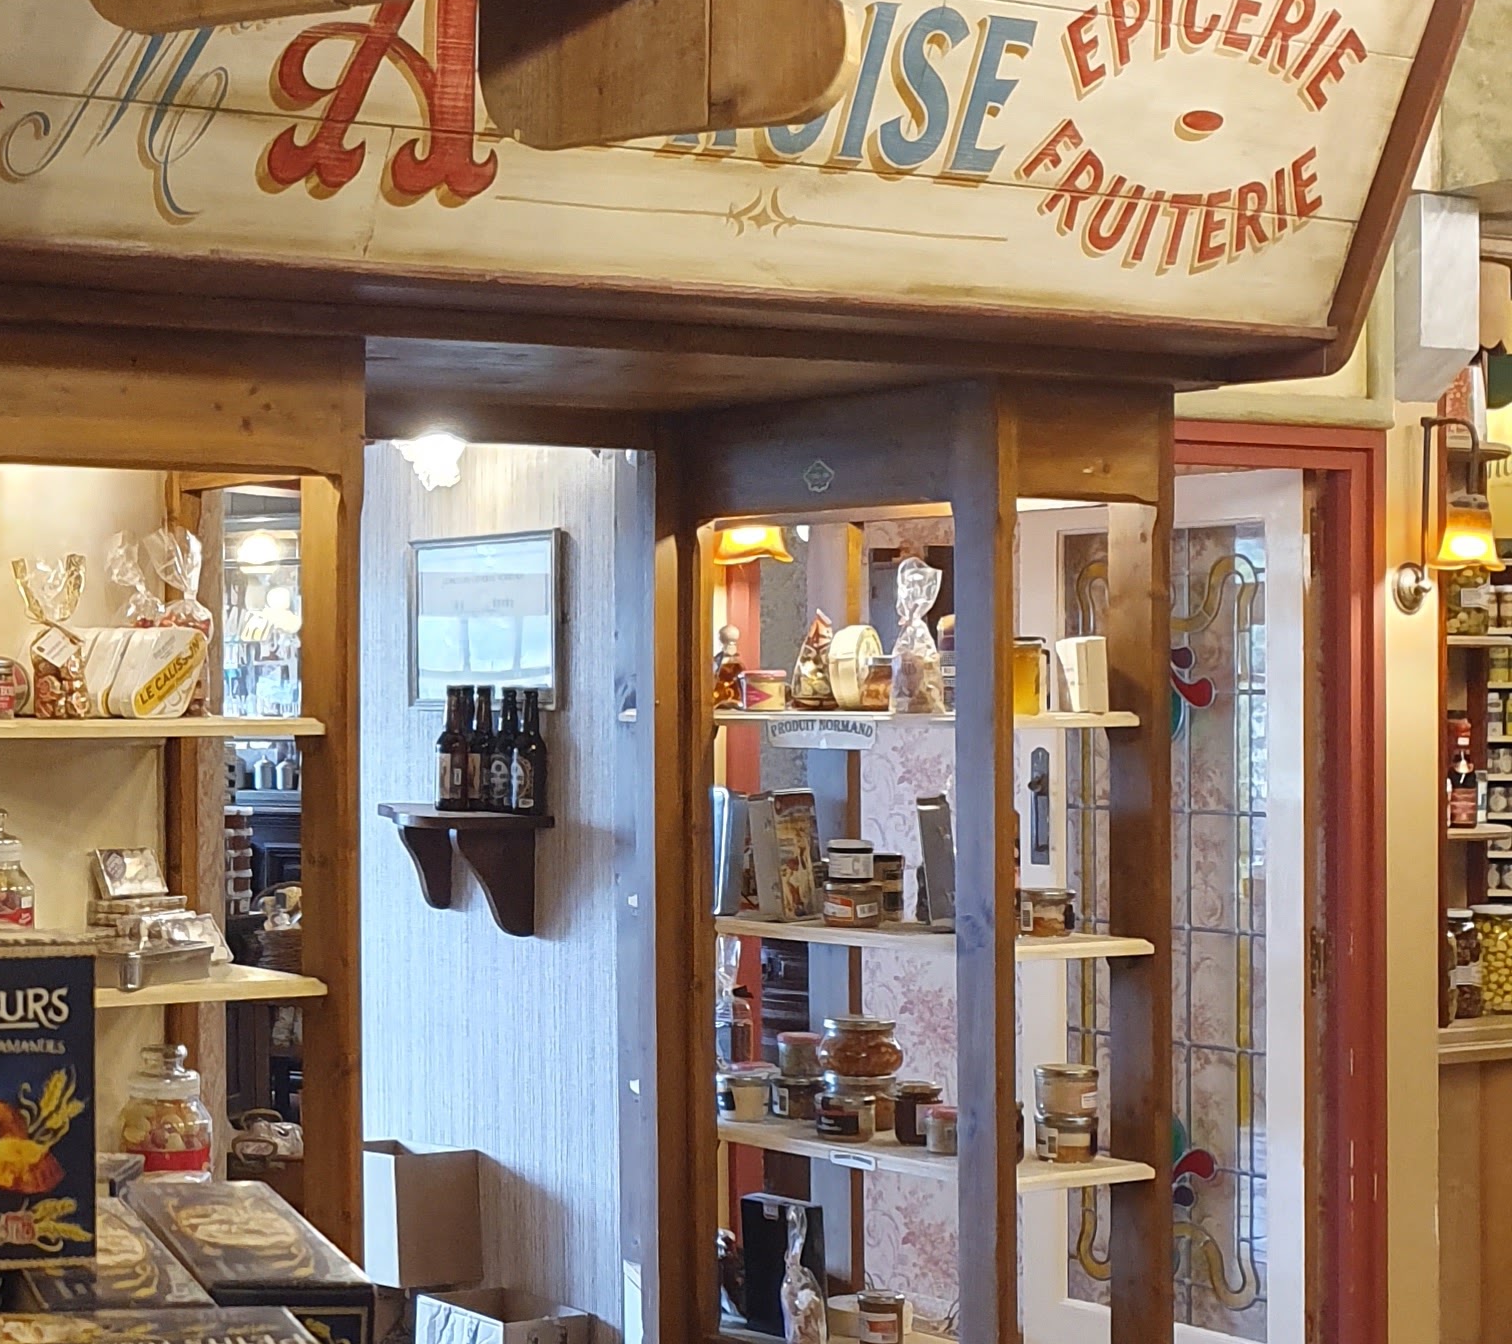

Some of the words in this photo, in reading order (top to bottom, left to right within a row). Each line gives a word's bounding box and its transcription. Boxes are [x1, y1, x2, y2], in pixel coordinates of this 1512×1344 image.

[1014, 115, 1326, 277] FRUITERIE
[138, 684, 156, 707] LE
[770, 719, 817, 737] PRODUIT
[819, 718, 874, 738] NORMAND
